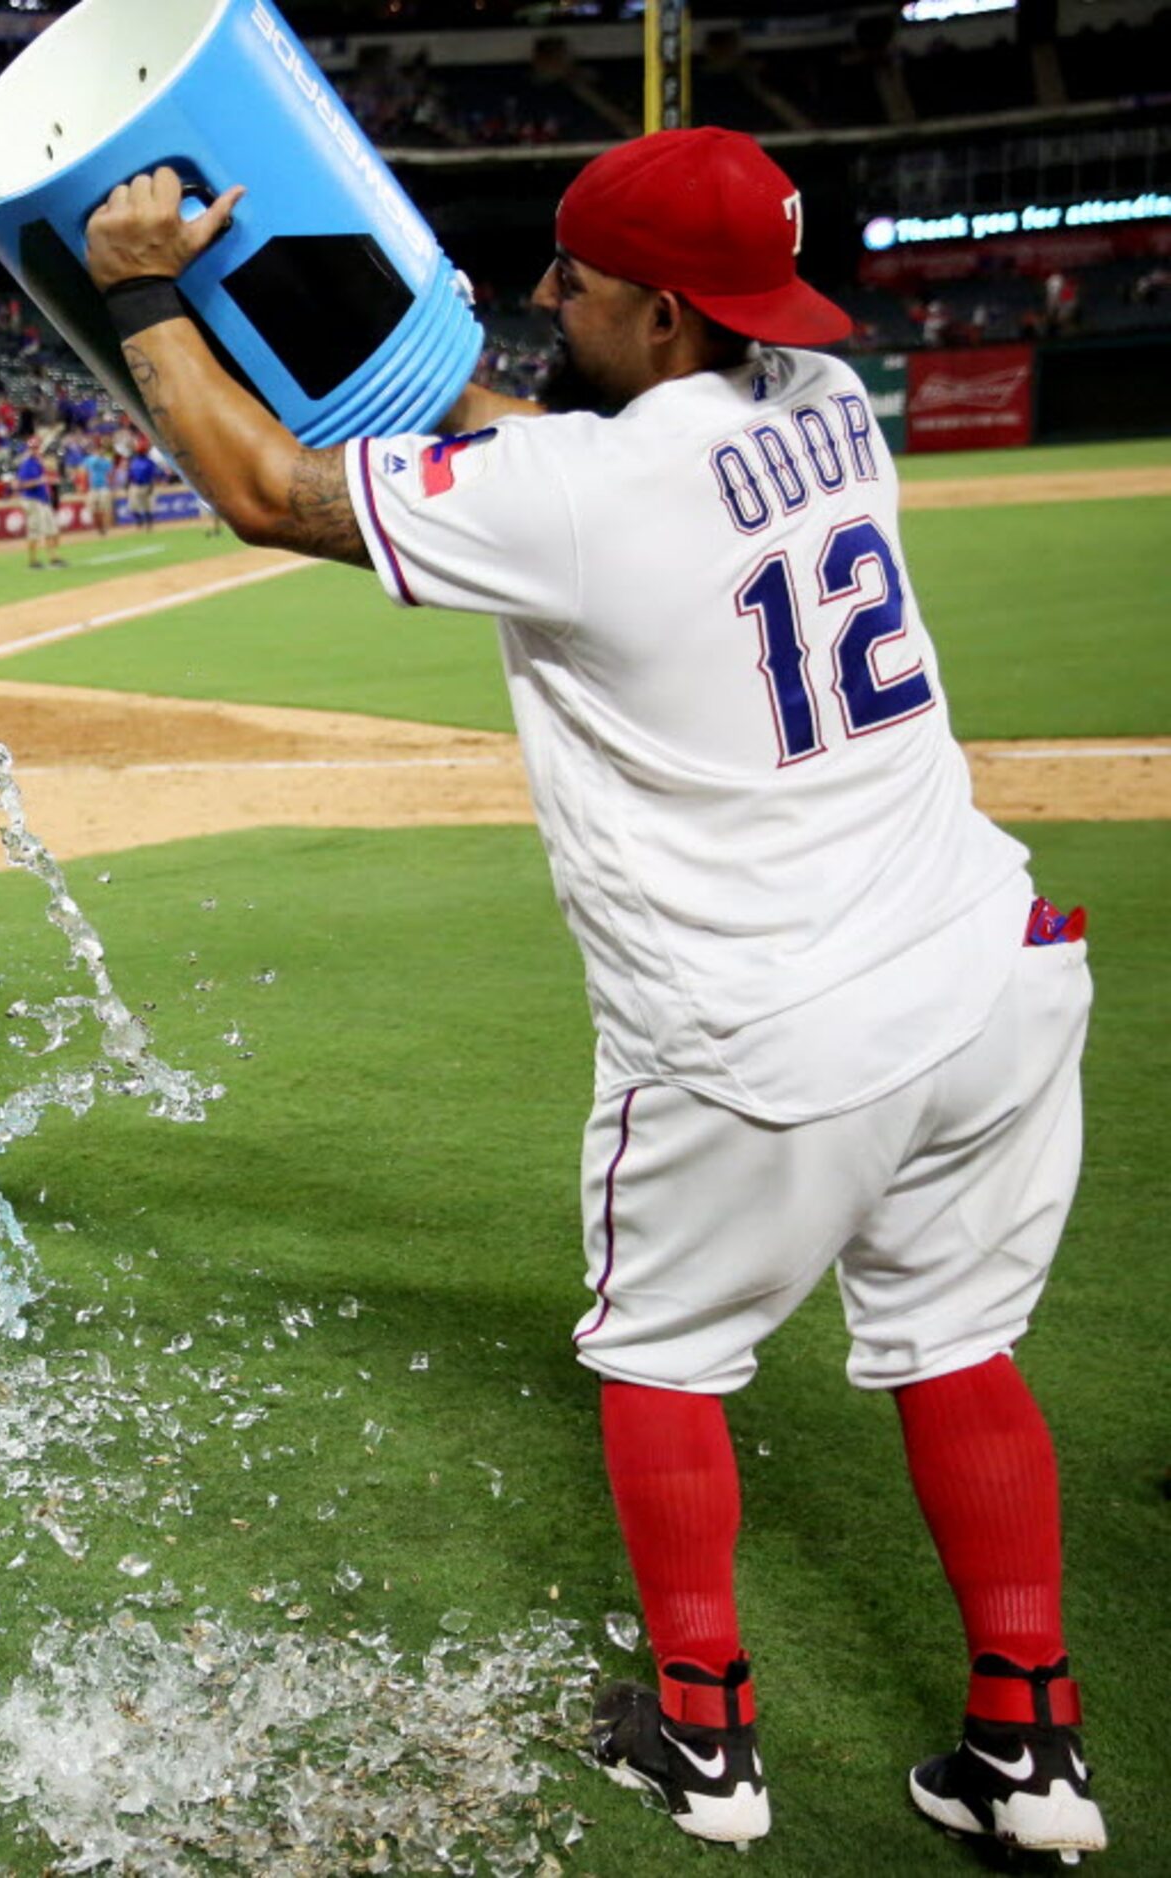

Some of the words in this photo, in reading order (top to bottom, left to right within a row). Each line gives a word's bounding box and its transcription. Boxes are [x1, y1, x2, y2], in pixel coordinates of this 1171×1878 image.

[250, 0, 431, 259] POWERADE
[782, 189, 803, 256] T
[895, 213, 967, 242] Thank
[972, 211, 1017, 239] you
[1021, 205, 1062, 230] for
[709, 393, 879, 536] ODOR
[734, 514, 936, 769] 12
